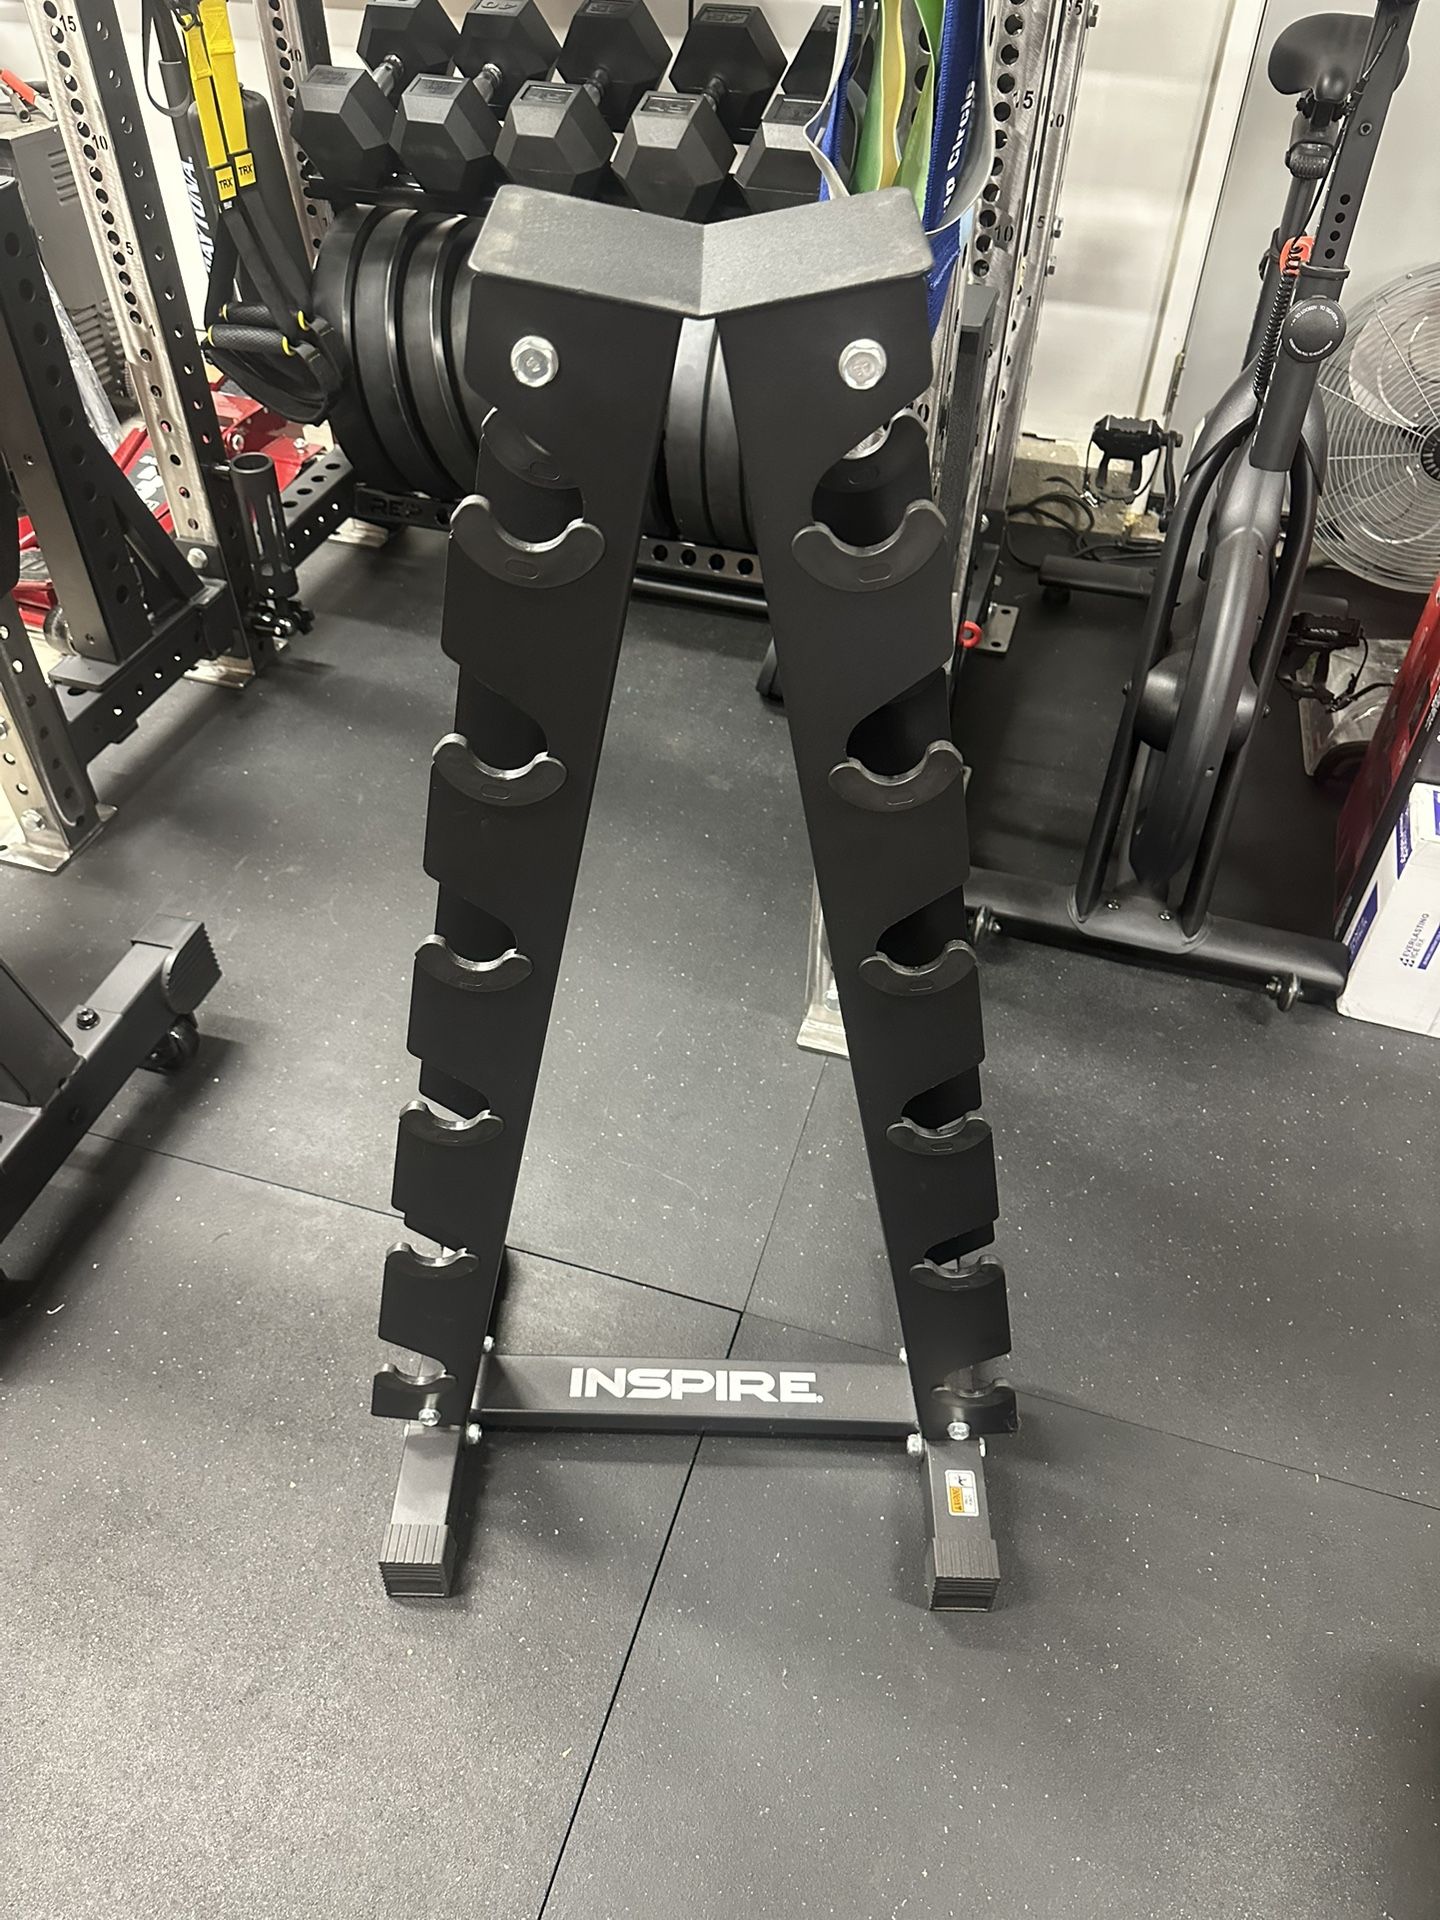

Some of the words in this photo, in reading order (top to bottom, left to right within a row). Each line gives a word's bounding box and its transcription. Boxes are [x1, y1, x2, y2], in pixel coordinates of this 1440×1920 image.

[59, 14, 77, 33] 15
[287, 48, 302, 63] 10
[1012, 90, 1034, 110] 15
[92, 134, 108, 151] 10
[238, 163, 253, 177] TRX
[218, 177, 234, 191] TRX
[1037, 215, 1046, 229] 5
[994, 224, 1014, 242] 10
[125, 241, 134, 256] 5
[1026, 295, 1032, 308] 1
[149, 323, 156, 337] 1
